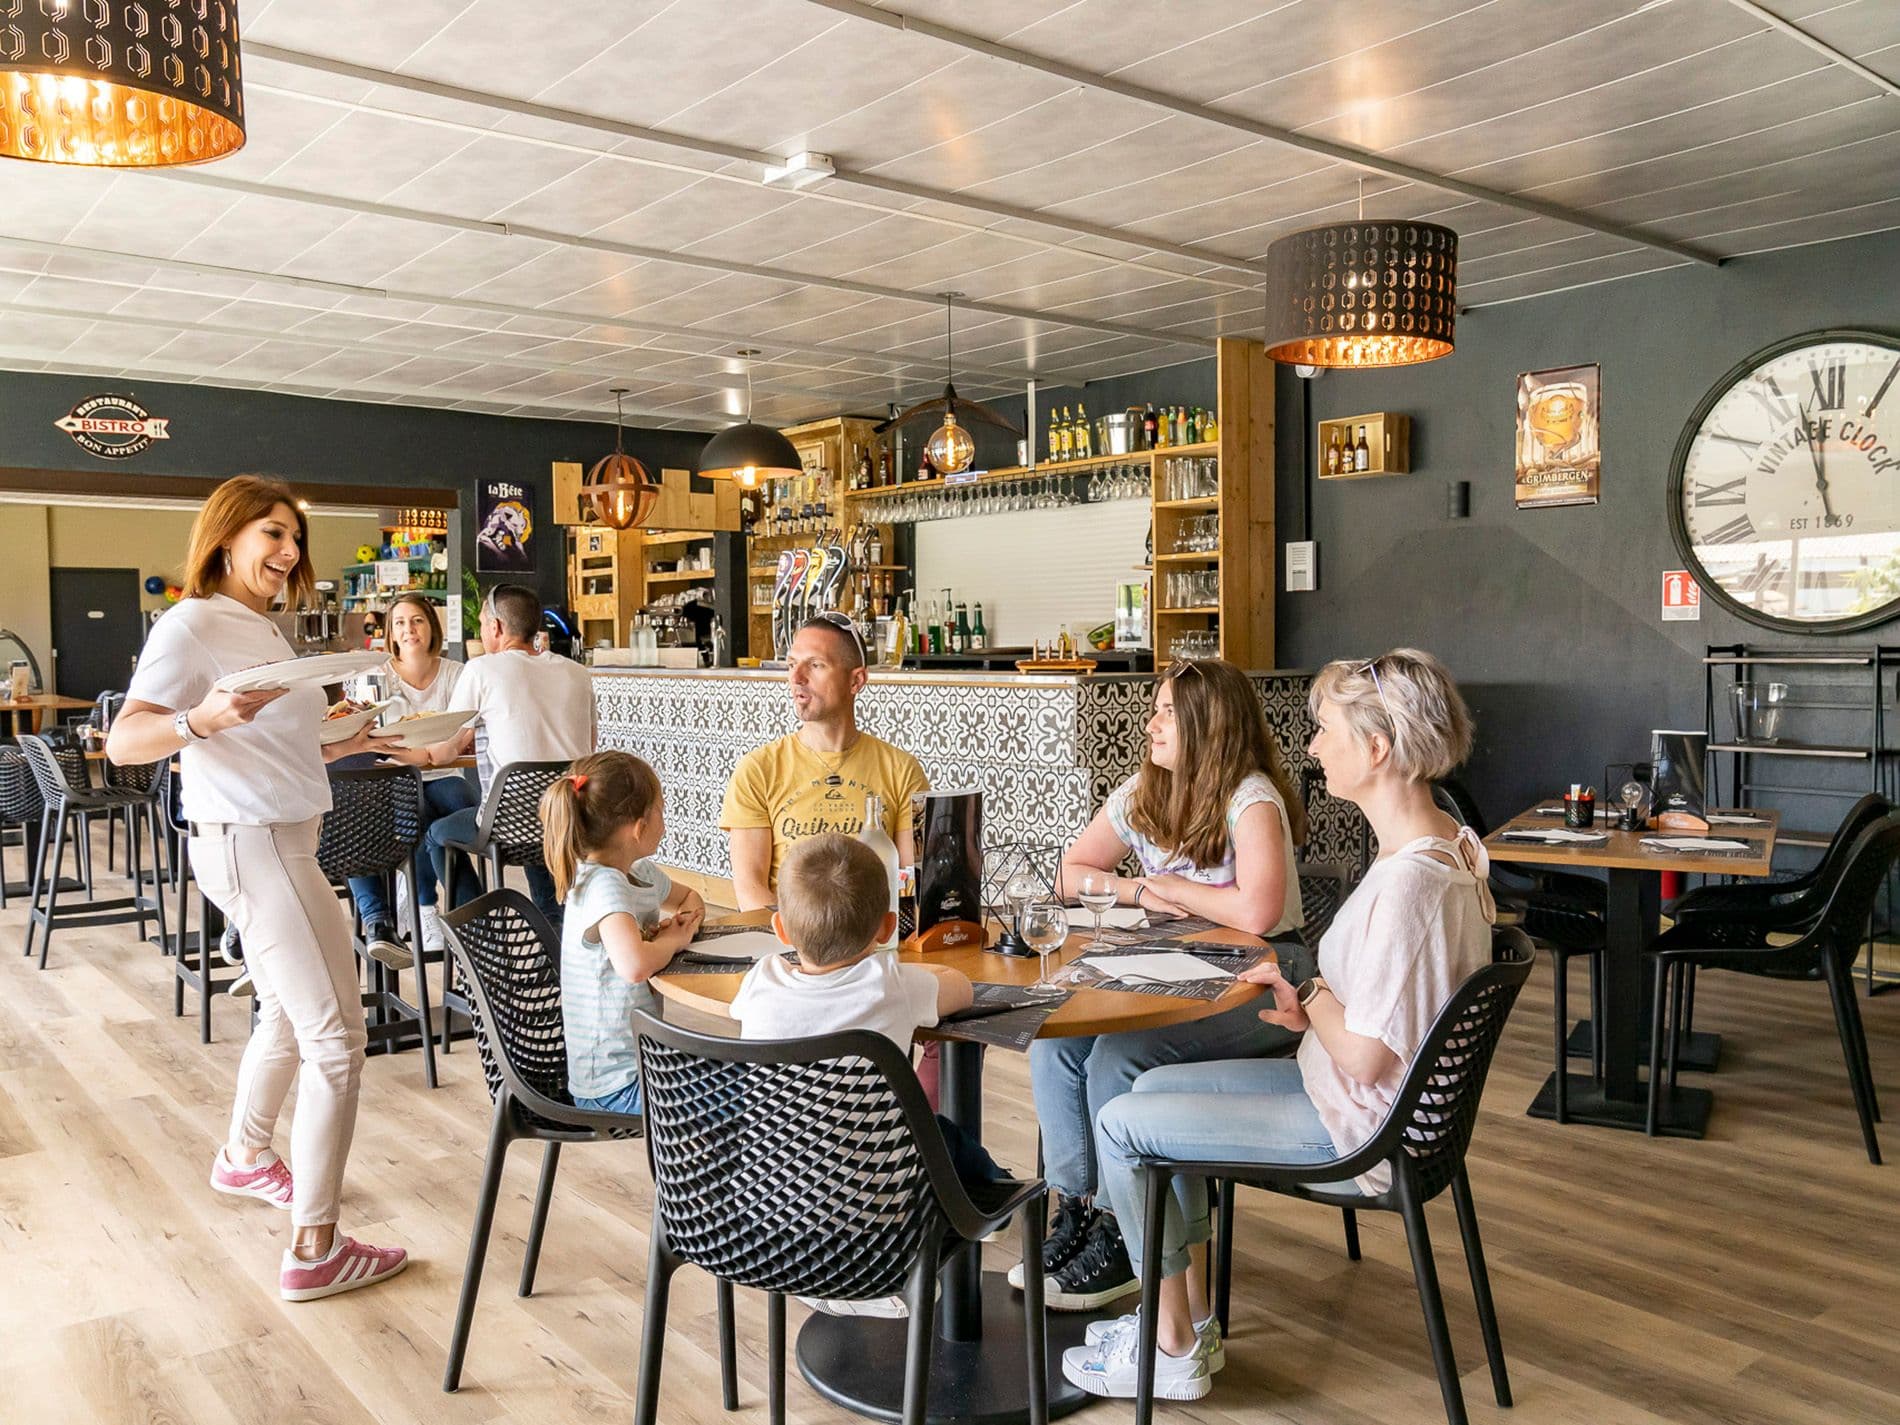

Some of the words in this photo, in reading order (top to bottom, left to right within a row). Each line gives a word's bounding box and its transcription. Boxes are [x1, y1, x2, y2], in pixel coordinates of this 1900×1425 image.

[76, 397, 148, 418] RESTAURANT
[82, 420, 145, 433] BISTRO
[77, 434, 103, 452] BON
[104, 437, 149, 455] APPETIT
[1757, 419, 1832, 474] VINTAGE
[1839, 421, 1900, 474] CLOCK
[1527, 470, 1588, 484] GRIMBERGEN
[1790, 517, 1809, 530] EST
